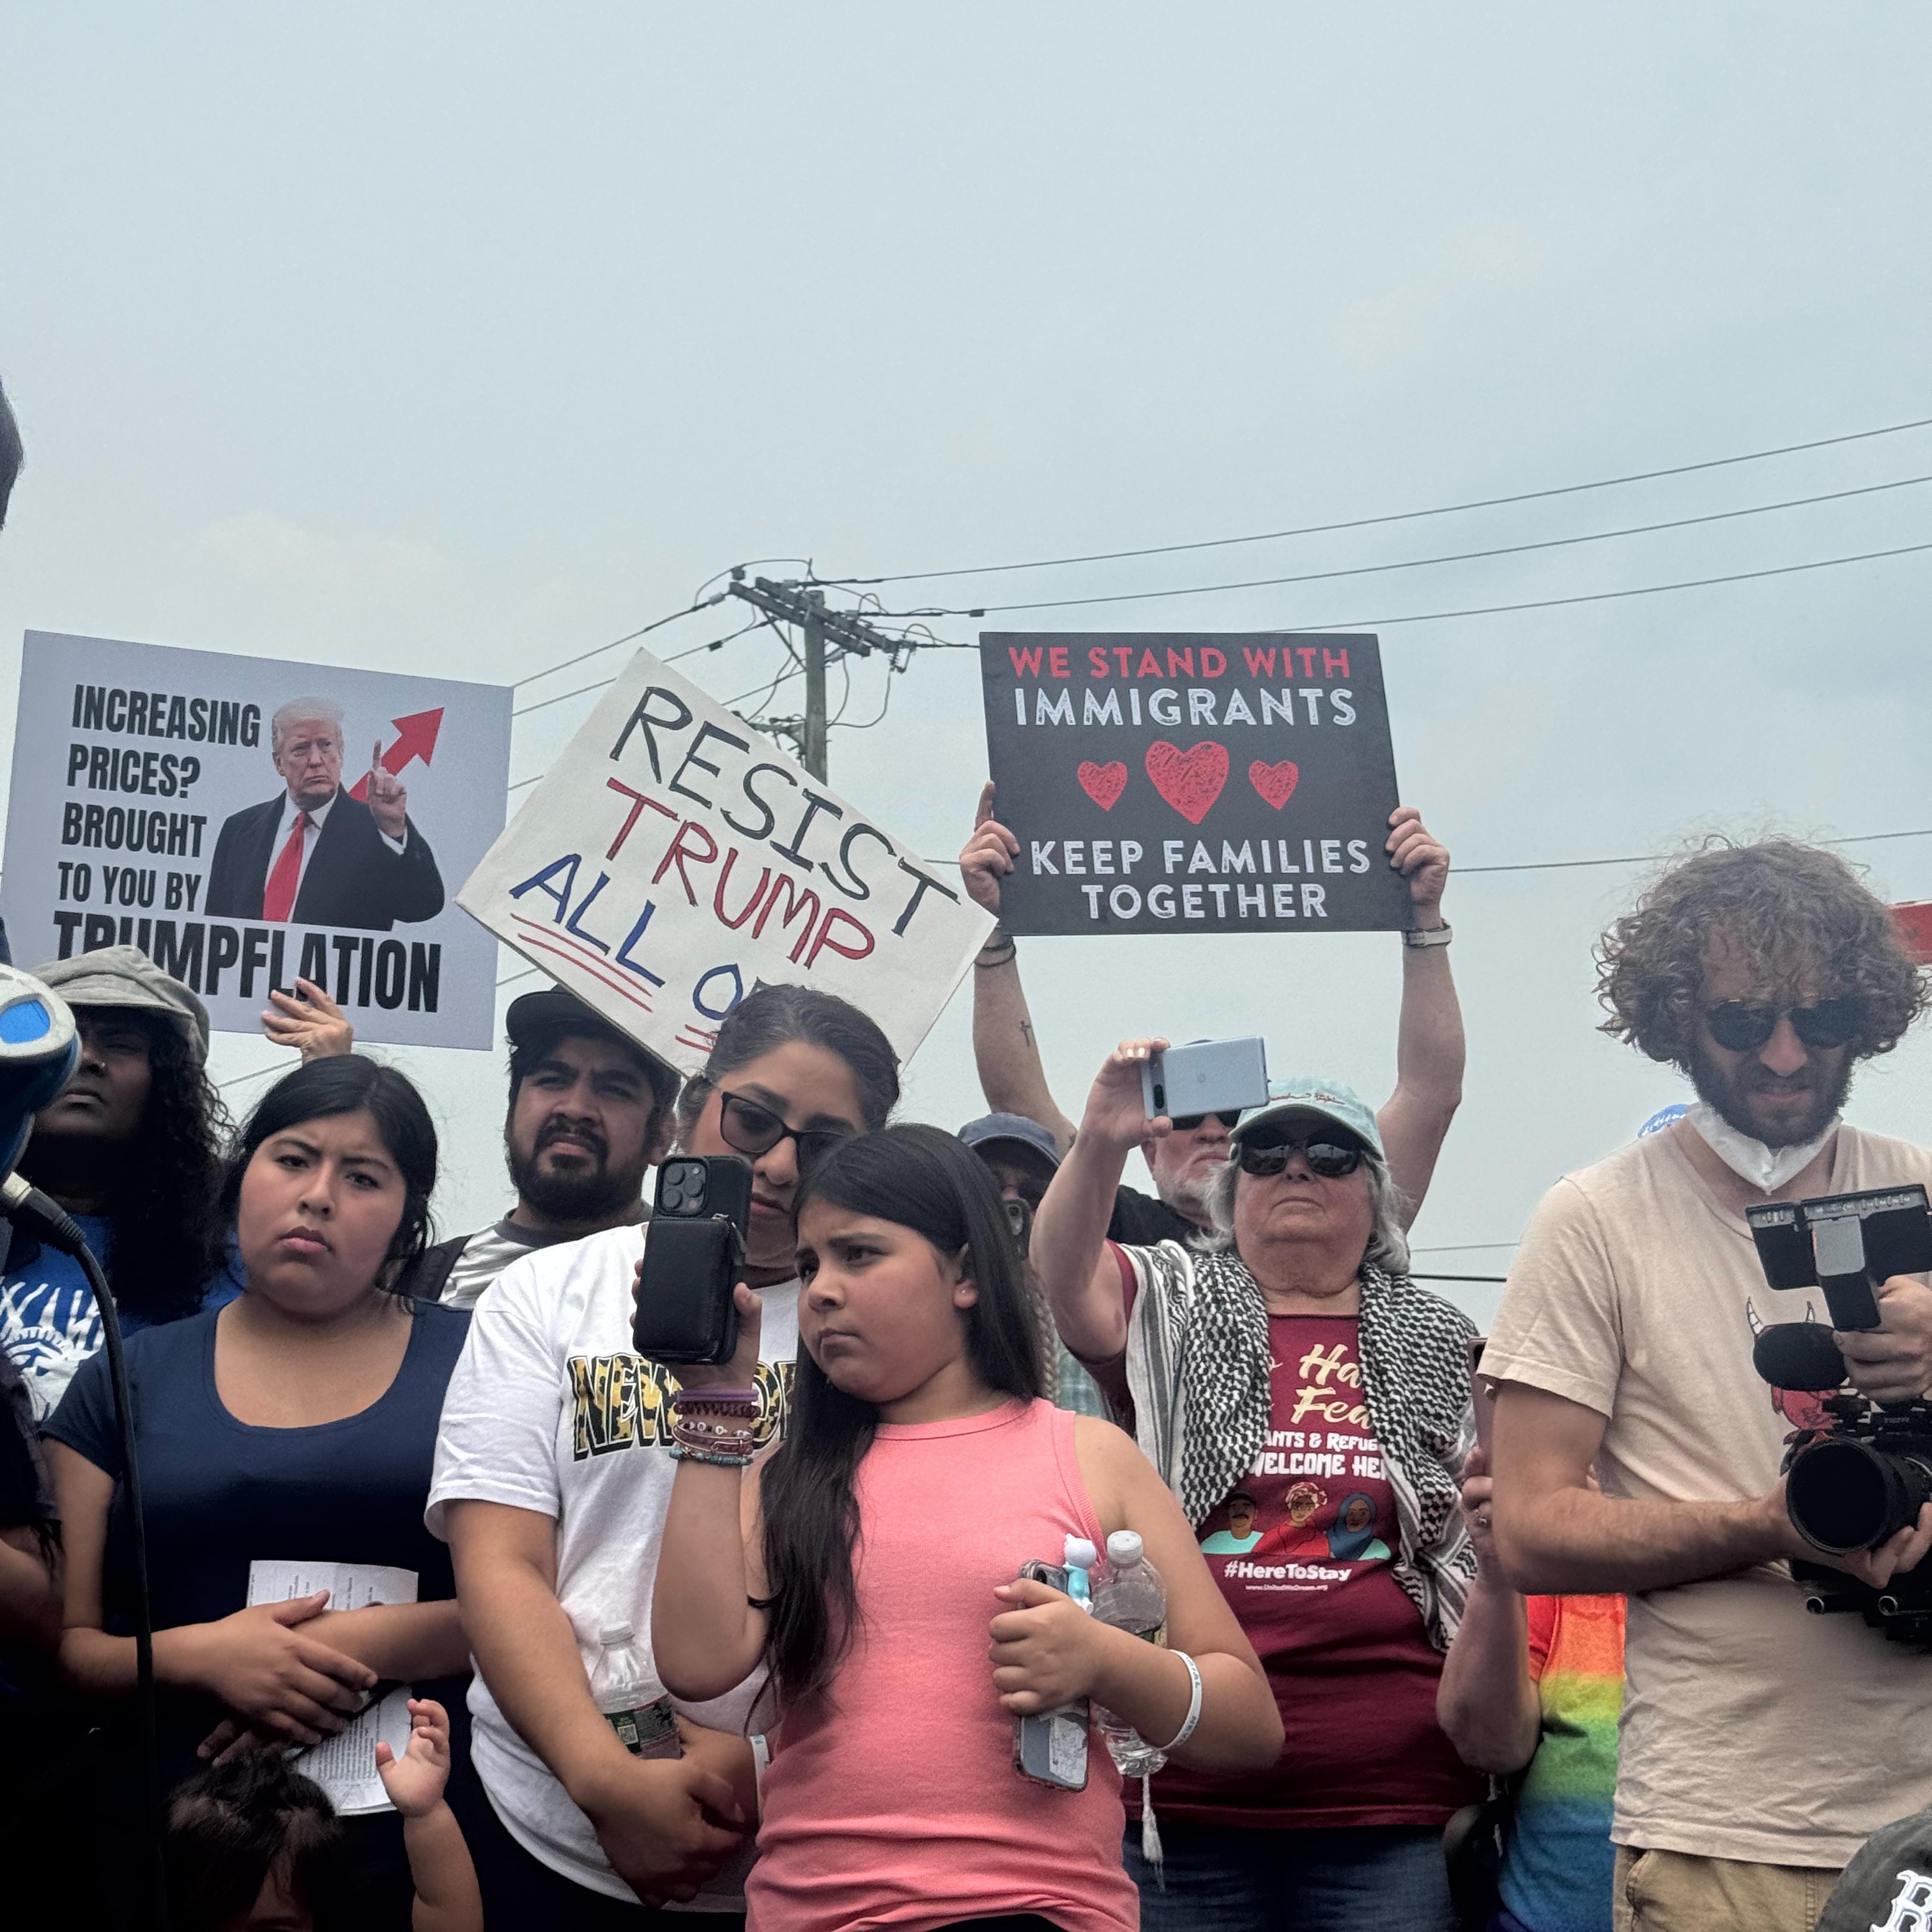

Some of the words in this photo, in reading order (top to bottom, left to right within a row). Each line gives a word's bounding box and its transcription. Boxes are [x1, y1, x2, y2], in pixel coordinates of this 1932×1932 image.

[1009, 647, 1070, 678] WE
[1090, 647, 1227, 678] STAND
[1243, 647, 1350, 678] WITH
[72, 684, 261, 747] INCREASING
[1015, 687, 1356, 726] IMMIGRANTS
[66, 744, 201, 799] PRICES?
[61, 802, 207, 858] BROUGHT
[610, 687, 961, 937] RESIST
[606, 777, 875, 969] TRUMP
[1031, 839, 1142, 875] KEEP
[1163, 839, 1370, 875] FAMILIES
[57, 862, 90, 901] TO
[103, 866, 157, 908] YOU
[165, 872, 201, 912] BY
[1081, 883, 1327, 919] TOGETHER
[509, 853, 665, 988] ALL
[693, 963, 760, 1020] O
[1299, 1344, 1362, 1388] Ha
[1291, 1386, 1372, 1429] Fea
[1309, 1432, 1322, 1448] &
[1326, 1432, 1379, 1452] REFUG
[1352, 1455, 1387, 1480] HE
[1224, 1560, 1352, 1581] #HereToStay
